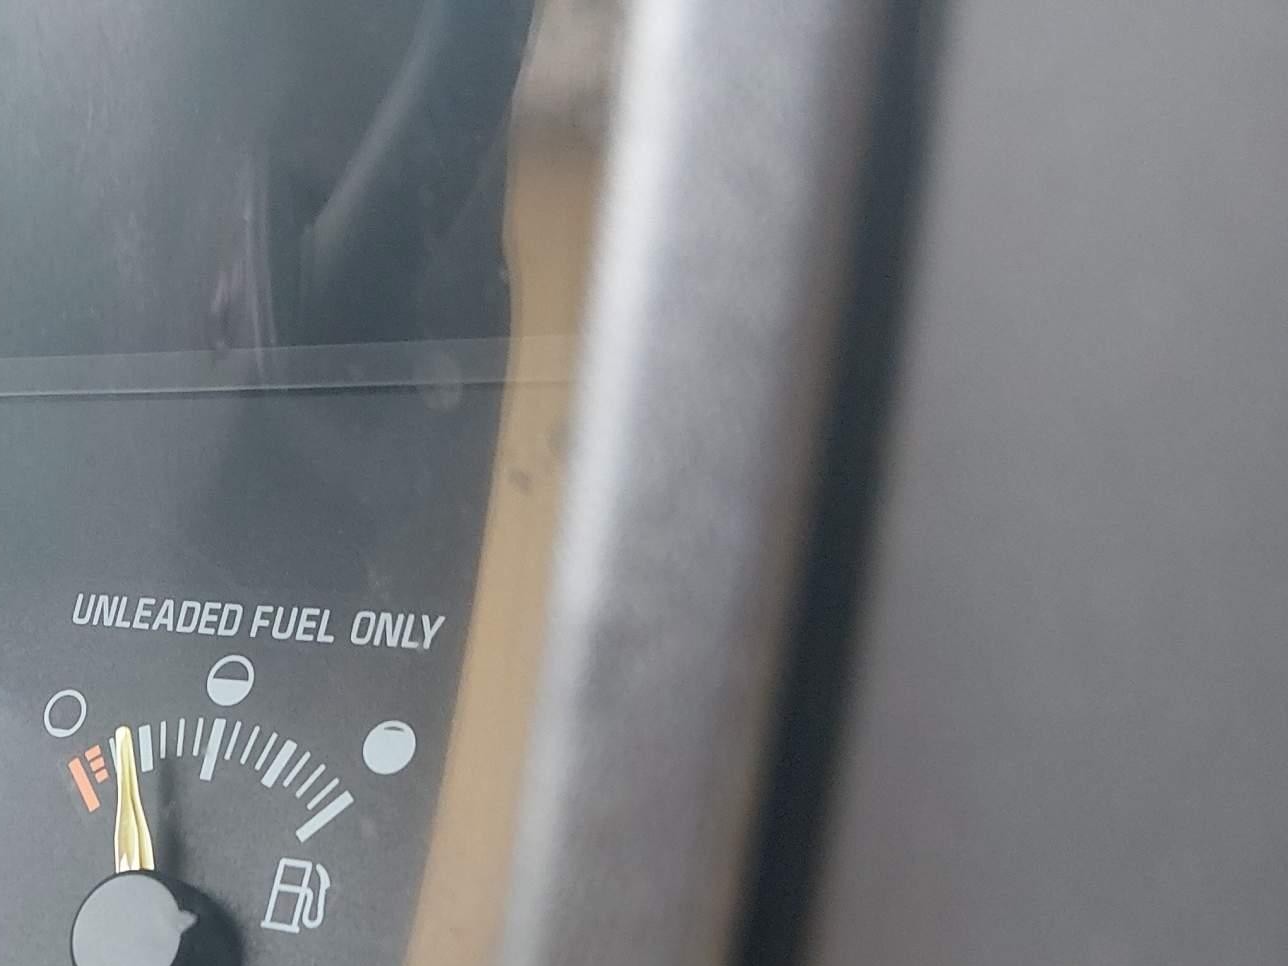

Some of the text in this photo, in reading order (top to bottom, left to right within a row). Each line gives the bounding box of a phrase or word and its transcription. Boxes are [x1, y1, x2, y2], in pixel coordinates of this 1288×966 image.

[72, 593, 446, 650] UNLEADED FUEL ONLY
